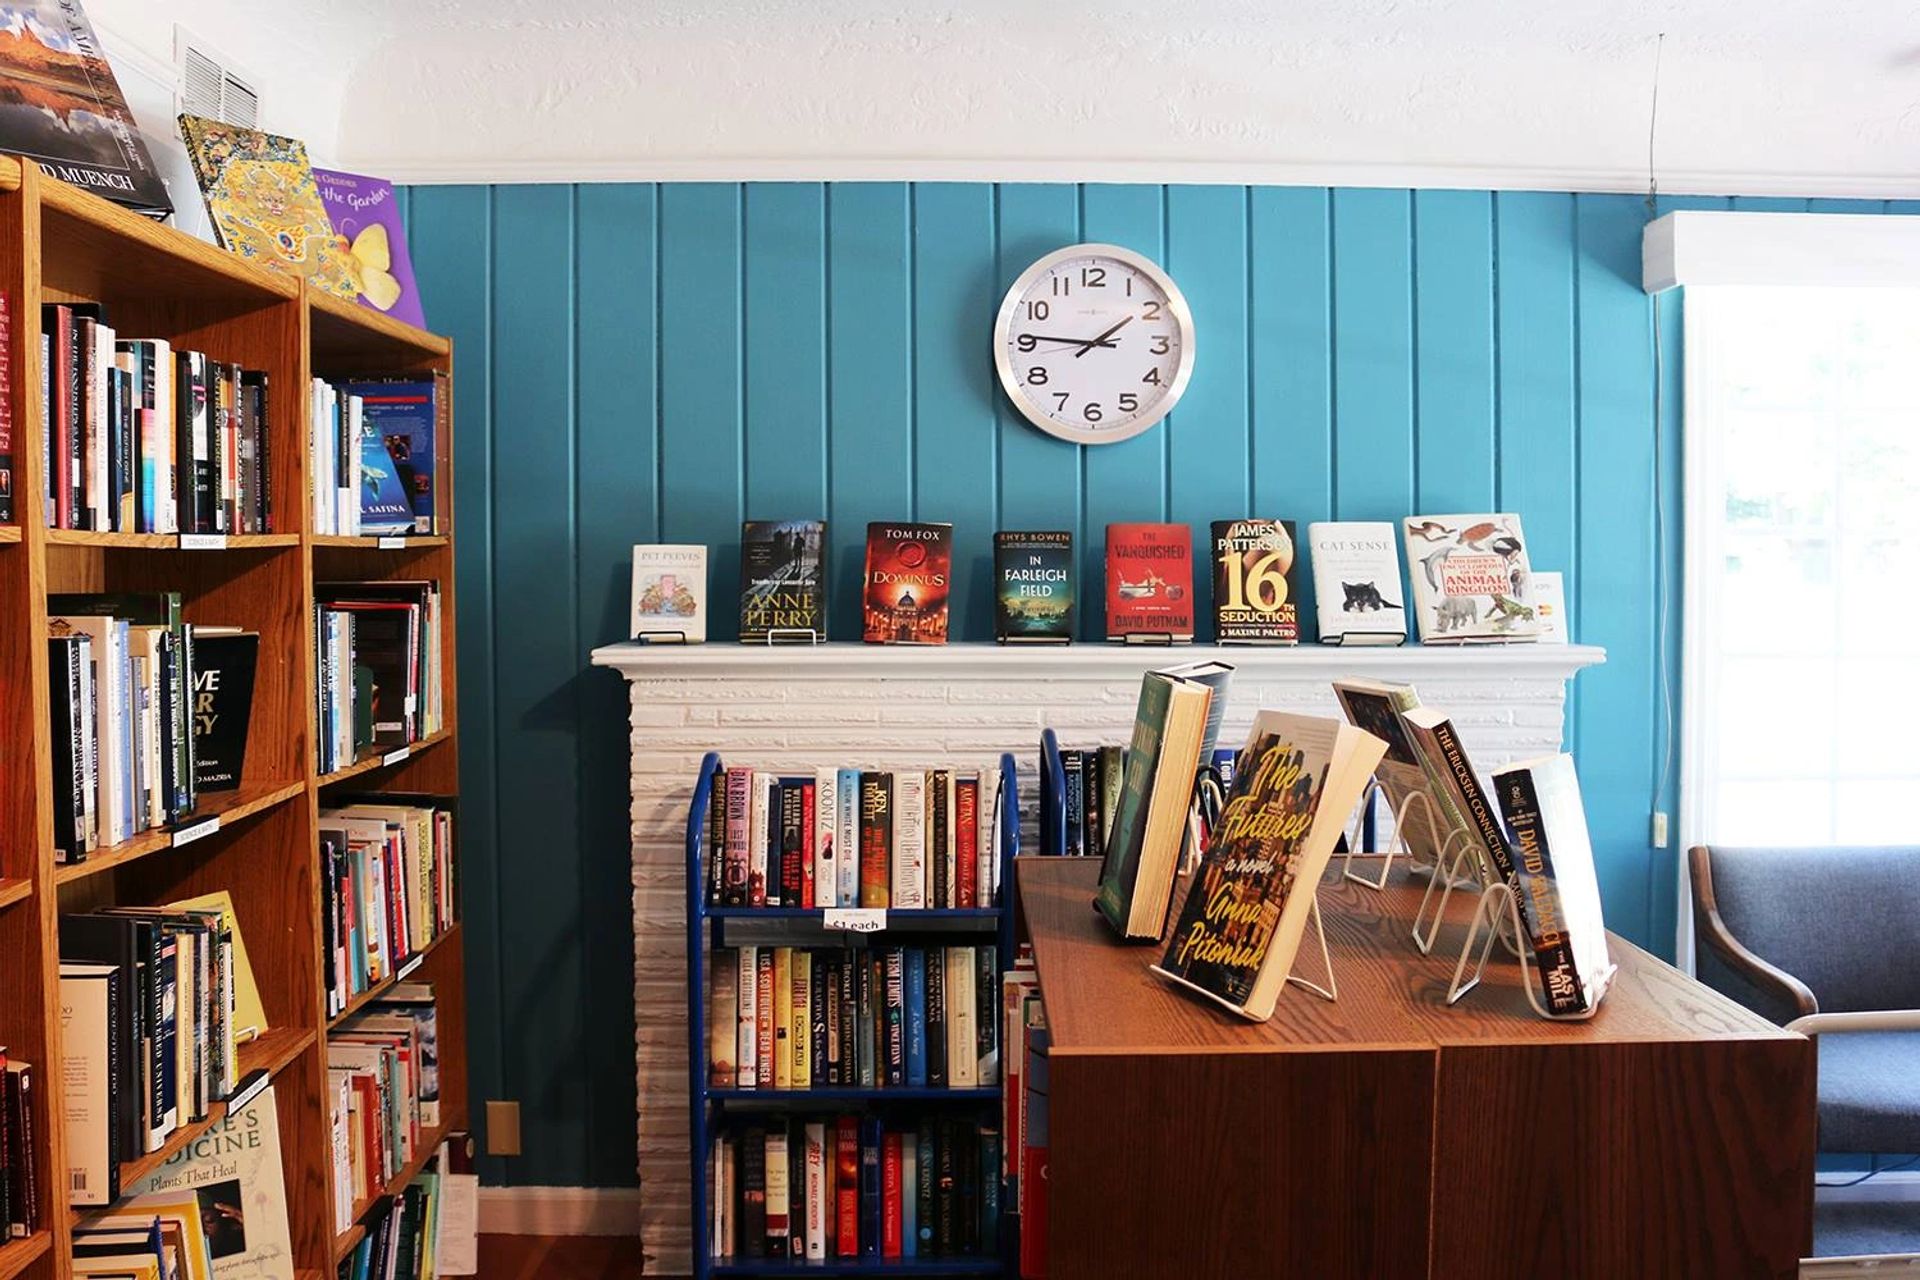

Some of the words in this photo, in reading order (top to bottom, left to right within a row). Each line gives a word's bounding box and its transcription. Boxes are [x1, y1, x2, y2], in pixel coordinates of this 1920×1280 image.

[58, 166, 136, 192] MUENCH
[324, 187, 345, 204] the
[347, 187, 390, 212] Garden
[1053, 277, 1069, 296] 11
[1081, 268, 1106, 287] 12
[1127, 278, 1131, 296] 1
[1028, 301, 1049, 320] 10
[1142, 301, 1160, 320] 2
[1017, 334, 1037, 352] 9
[1150, 336, 1169, 355] 3
[1027, 367, 1048, 385] 8
[1142, 367, 1161, 386] 4
[1052, 393, 1069, 411] 7
[1118, 393, 1138, 412] 5
[1084, 403, 1102, 421] 6
[368, 504, 406, 514] SAFINA
[885, 529, 912, 539] TOM
[915, 530, 940, 541] FOX
[1000, 533, 1027, 542] RHYS
[1030, 534, 1070, 542] BOWEN
[1142, 532, 1156, 542] THE
[1234, 525, 1275, 537] JAMES
[1114, 544, 1184, 559] VANQUISHED
[1320, 540, 1347, 551] CAT
[1349, 540, 1391, 551] SENSE
[641, 552, 667, 561] PET
[670, 552, 700, 561] PEEVES
[1029, 556, 1041, 565] IN
[873, 571, 945, 586] DOMINUS
[1005, 568, 1067, 582] FARLEIGH
[1219, 552, 1288, 611] 16
[1447, 575, 1508, 585] ANIMAL
[1020, 585, 1052, 597] FIELD
[1447, 585, 1508, 595] KINGDOM
[748, 593, 815, 609] ANNE
[746, 609, 818, 627] PERRY
[1114, 614, 1143, 628] DAVID
[1146, 615, 1188, 628] PUTNAM
[1220, 612, 1296, 622] SEDUCTION
[730, 771, 746, 788] DAN
[1257, 744, 1303, 797] The
[863, 782, 878, 822] FOLLETT
[874, 790, 887, 813] KEN
[960, 786, 973, 805] AMY
[1438, 727, 1454, 751] THE
[1447, 747, 1477, 800] ERICKSEN
[1471, 798, 1511, 869] CONNECTION
[730, 791, 745, 820] BROWN
[792, 788, 801, 826] WILLIAM
[820, 781, 834, 831] KOONTZ
[843, 806, 852, 827] WHITE
[1219, 795, 1312, 849] Futures
[843, 829, 852, 849] MUST
[843, 850, 852, 862] DIE
[1517, 828, 1544, 875] DAVID
[1224, 859, 1236, 873] a
[1235, 854, 1275, 875] novel
[1206, 883, 1262, 925] Anne
[850, 920, 879, 930] each
[1178, 922, 1264, 972] Pitoniak
[759, 953, 770, 972] LISA
[886, 952, 900, 978] TERM
[842, 963, 852, 1001] BROKER
[1546, 969, 1568, 1010] MILE
[1556, 962, 1578, 1005] LAST
[759, 974, 770, 1020] SCOTTOLINE
[815, 980, 824, 1021] GRAFTON
[887, 980, 901, 1008] LIMITS
[812, 1022, 826, 1033] S
[890, 1023, 900, 1044] VINCE
[760, 1031, 770, 1052] DEAD
[795, 1048, 804, 1067] FAST
[843, 1043, 851, 1084] GRISHAM
[891, 1044, 900, 1066] FLYNN
[759, 1054, 771, 1083] RINGER
[809, 1140, 821, 1168] PREY
[151, 1175, 183, 1192] Plants
[186, 1168, 210, 1183] That
[213, 1161, 237, 1179] Heal
